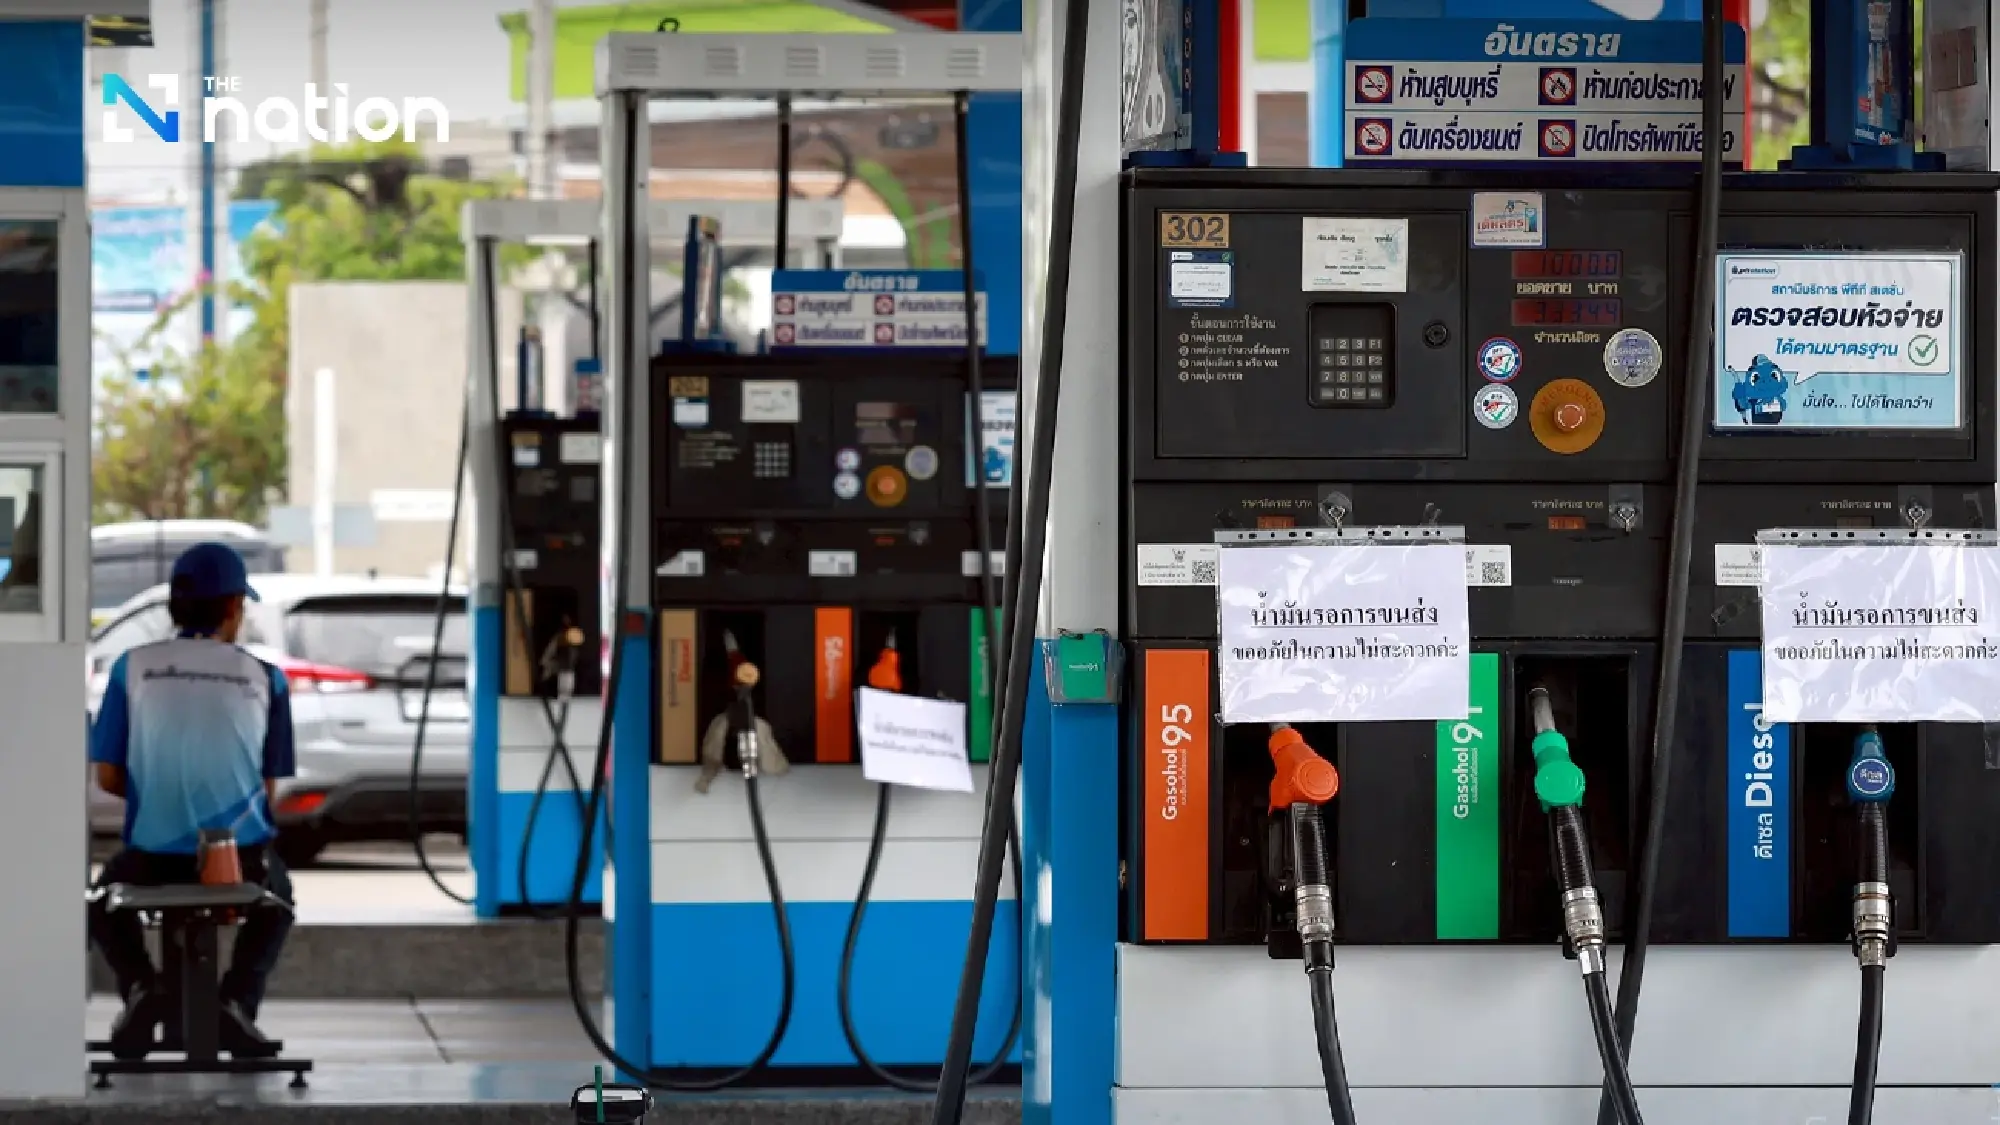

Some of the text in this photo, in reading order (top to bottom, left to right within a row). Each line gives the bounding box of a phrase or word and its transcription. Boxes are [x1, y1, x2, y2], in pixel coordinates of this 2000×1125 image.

[1484, 23, 1622, 57] อันตราย
[1400, 64, 1502, 106] ห้ามสูบบุหรี่
[1399, 115, 1522, 153] ดับเครื่องยนต์
[1168, 215, 1224, 242] 302
[1517, 283, 1618, 295] ยอดขาย บาท
[1772, 283, 1838, 295] สถานีบริการ
[1870, 280, 1904, 295] สเตชั่น
[1731, 300, 1944, 328] ตรวจสอบหัวจ่าย
[1775, 337, 1899, 359] ได้ตามมาตรฐาน
[1250, 591, 1438, 628] น้ำมันรอการขนส่ง
[1791, 590, 1979, 628] น้ำมันรอการขนส่ง
[1232, 636, 1459, 660] ขออภัยในความไม่สะดวกค่ะ
[1774, 637, 1998, 660] ขออภัยในความไม่สะดวกค่ะ
[1162, 704, 1192, 820] Gasohol 95
[1452, 747, 1468, 819] Gasohol
[1753, 813, 1773, 859] ดีเซล
